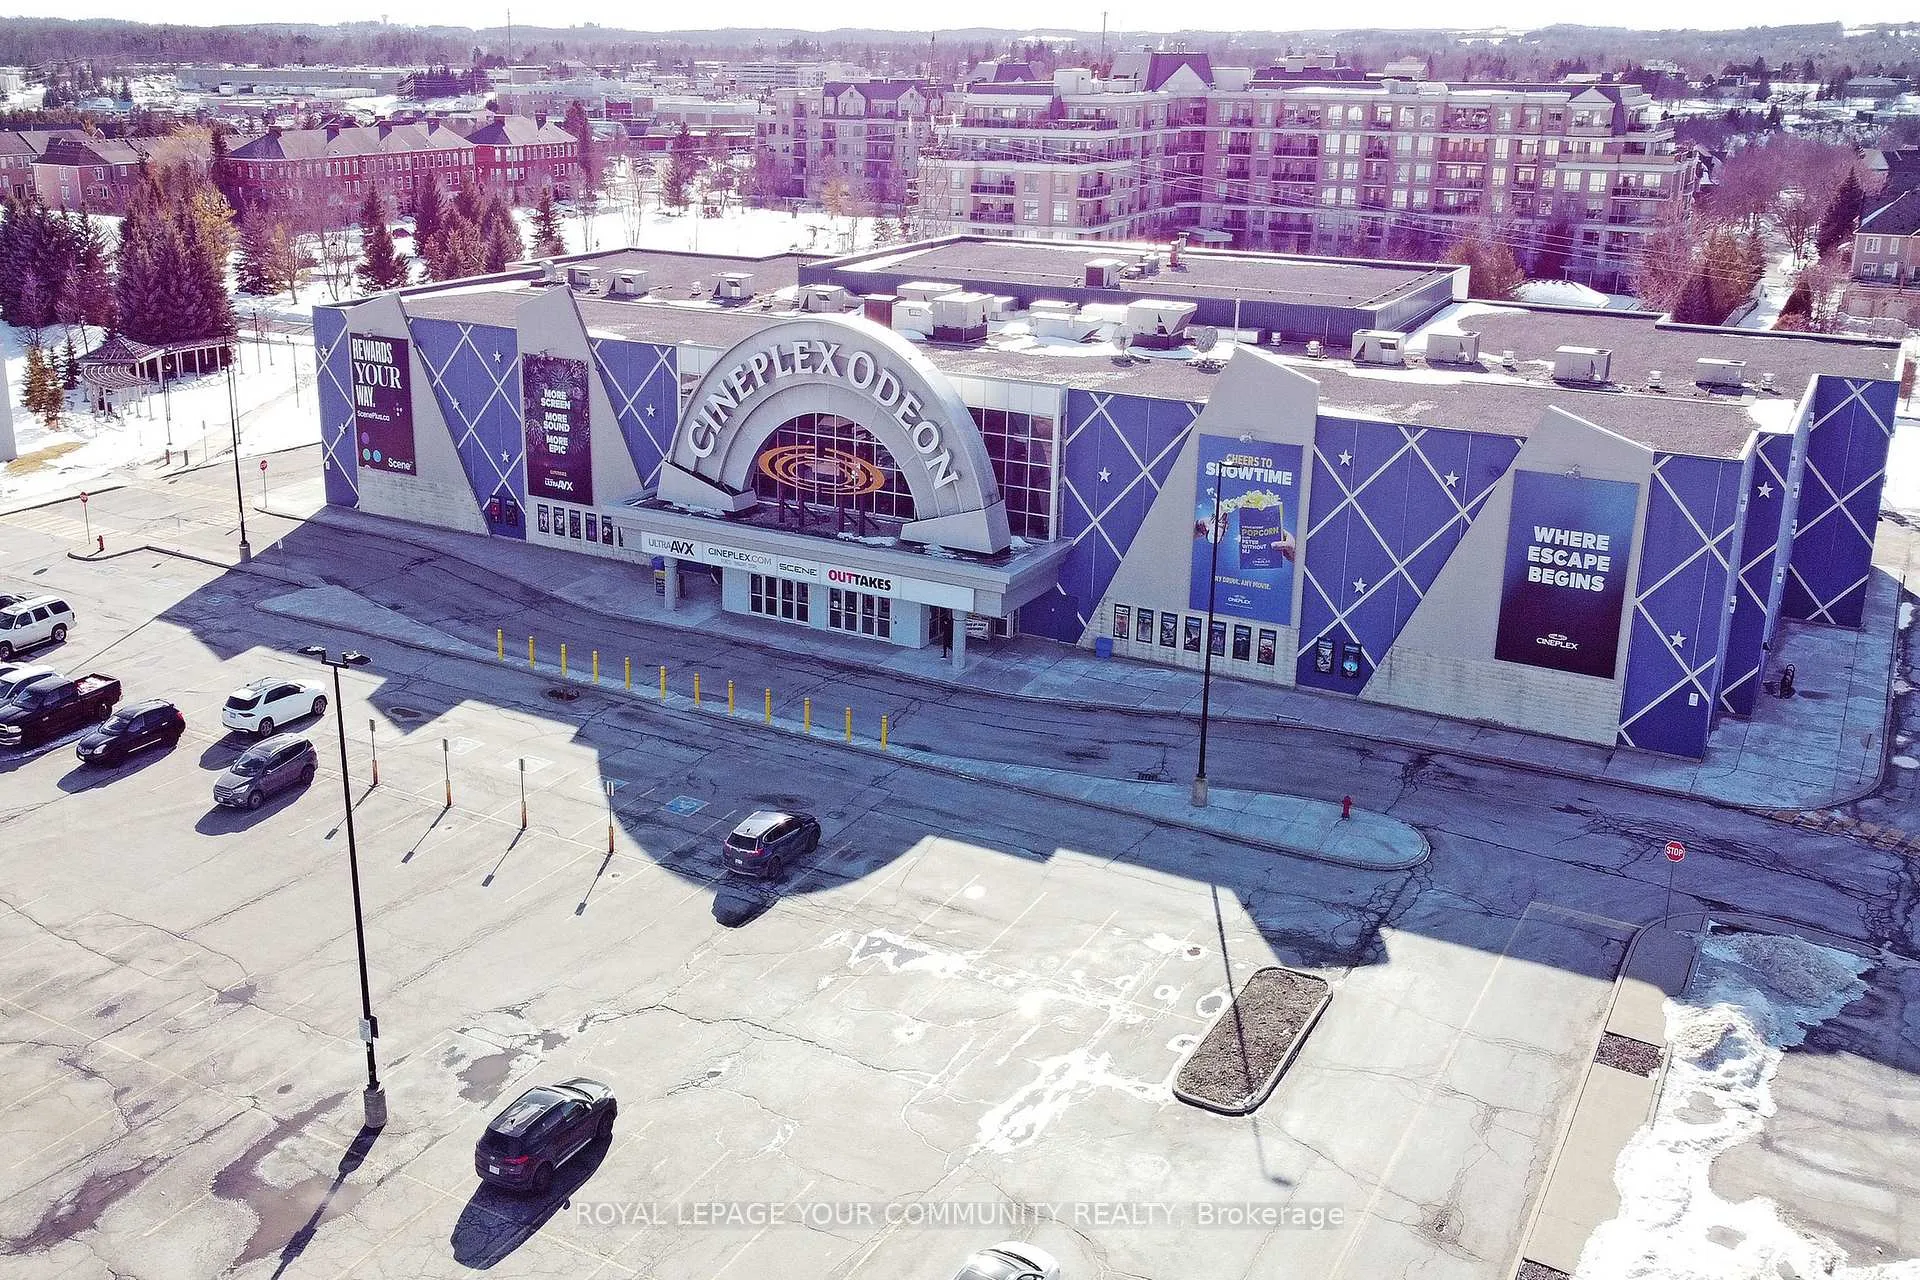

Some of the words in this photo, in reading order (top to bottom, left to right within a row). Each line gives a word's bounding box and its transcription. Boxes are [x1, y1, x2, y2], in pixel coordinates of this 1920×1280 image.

[352, 338, 392, 364] REWARDS
[354, 361, 402, 389] YOUR
[544, 389, 567, 400] MORE
[540, 398, 571, 410] SCREEN
[545, 411, 568, 423] MORE
[688, 339, 841, 459] CINEPLEX
[847, 351, 959, 490] ODEON
[543, 421, 570, 432] SOUND
[546, 434, 569, 446] MORE
[548, 444, 567, 455] EPIC
[1225, 453, 1259, 467] CHEERS
[1260, 457, 1273, 468] TO
[1205, 461, 1293, 486] SHOWTIME
[1241, 527, 1280, 537] POPCORN
[1533, 525, 1610, 551] WHERE
[708, 547, 772, 566] CINEPLEX.COM
[1527, 545, 1611, 572] ESCAPE
[779, 562, 818, 577] SCENE
[828, 569, 893, 592] OUTTAKES
[1527, 565, 1606, 592] BEGINS
[1536, 636, 1580, 651] CINEPLEX
[1666, 846, 1684, 856] STOP
